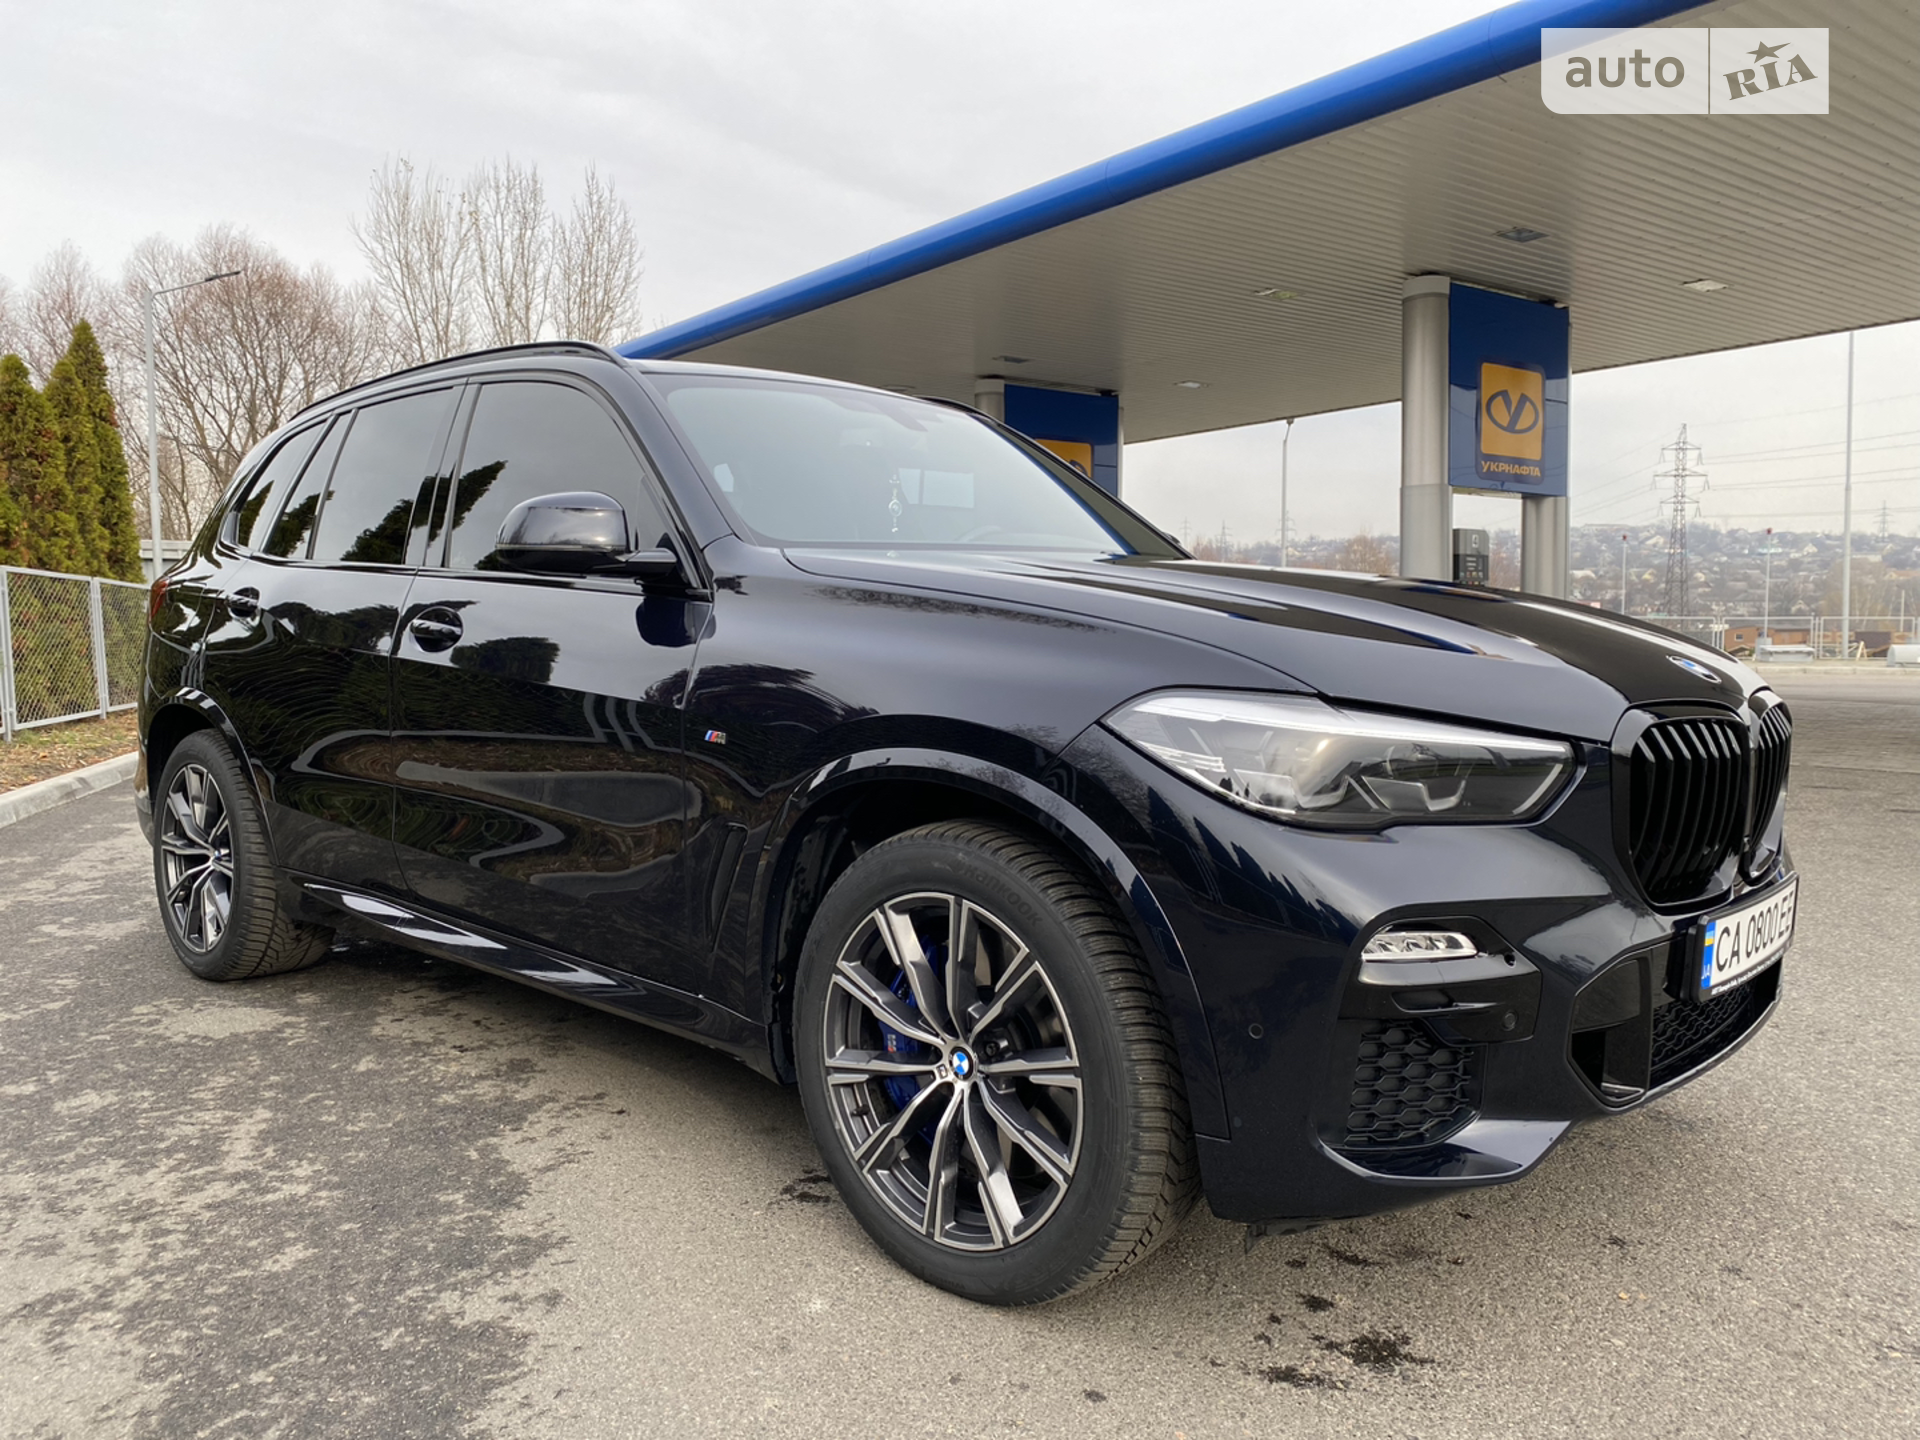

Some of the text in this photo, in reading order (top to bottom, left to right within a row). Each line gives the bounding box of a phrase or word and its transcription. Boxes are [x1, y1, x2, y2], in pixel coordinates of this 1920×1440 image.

[1481, 461, 1541, 477] УКРНАФТА
[1716, 921, 1740, 972] CA
[1746, 902, 1779, 959] 0800
